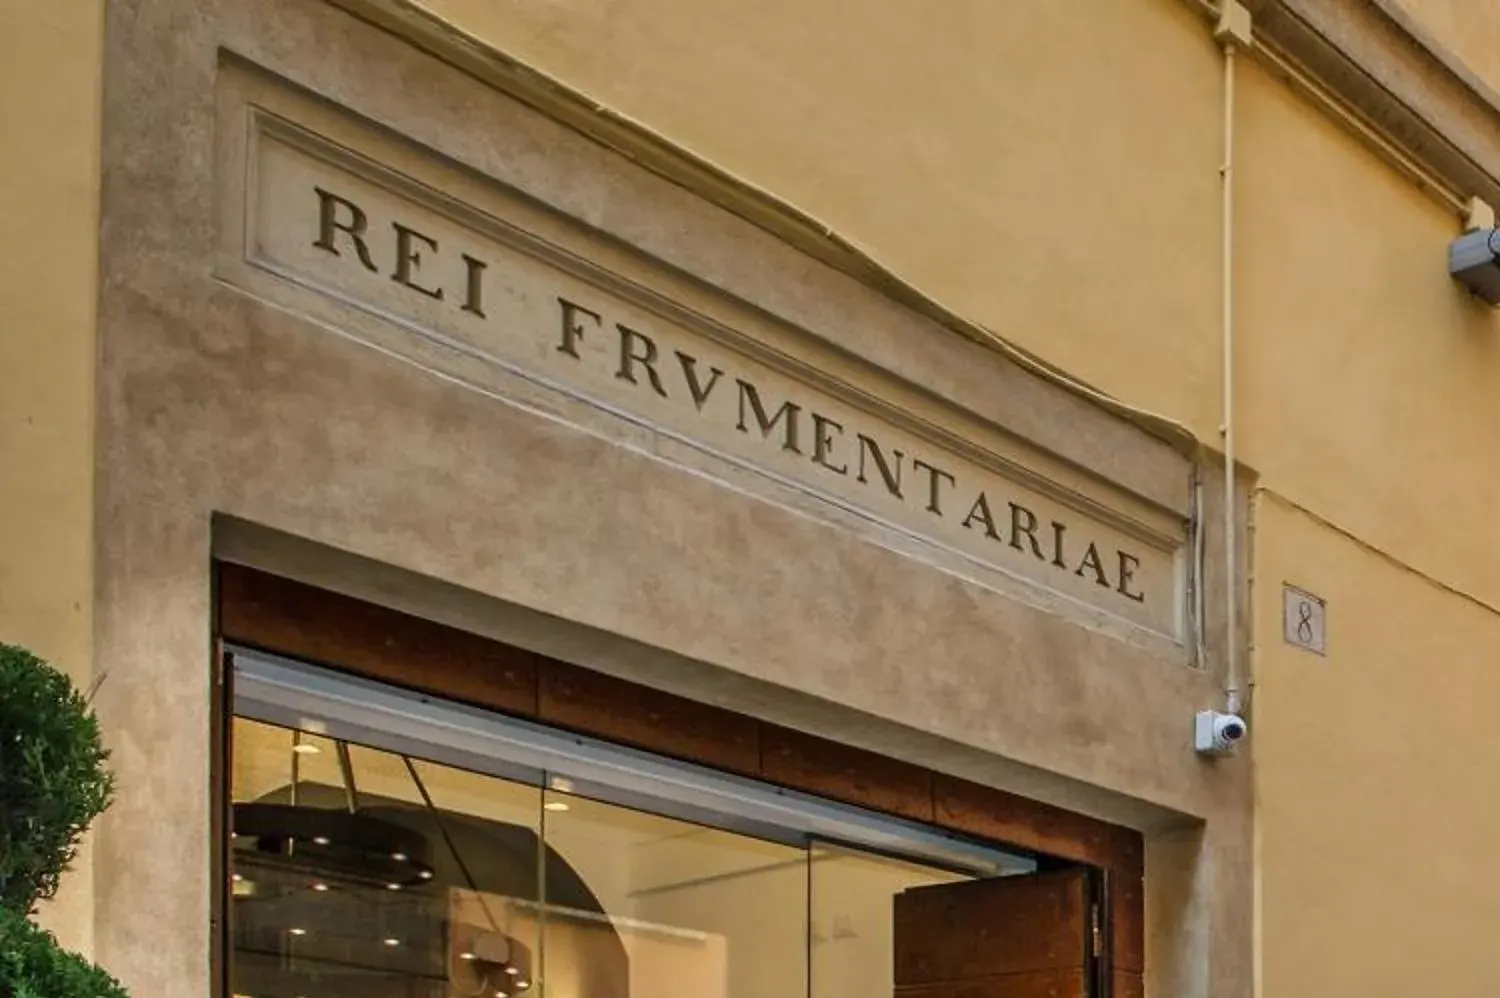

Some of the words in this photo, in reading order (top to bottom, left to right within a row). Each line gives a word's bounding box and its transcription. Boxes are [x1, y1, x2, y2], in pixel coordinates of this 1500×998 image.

[313, 185, 487, 320] REI
[556, 296, 1145, 603] FRVMENTARIAE
[1298, 601, 1313, 643] 8
